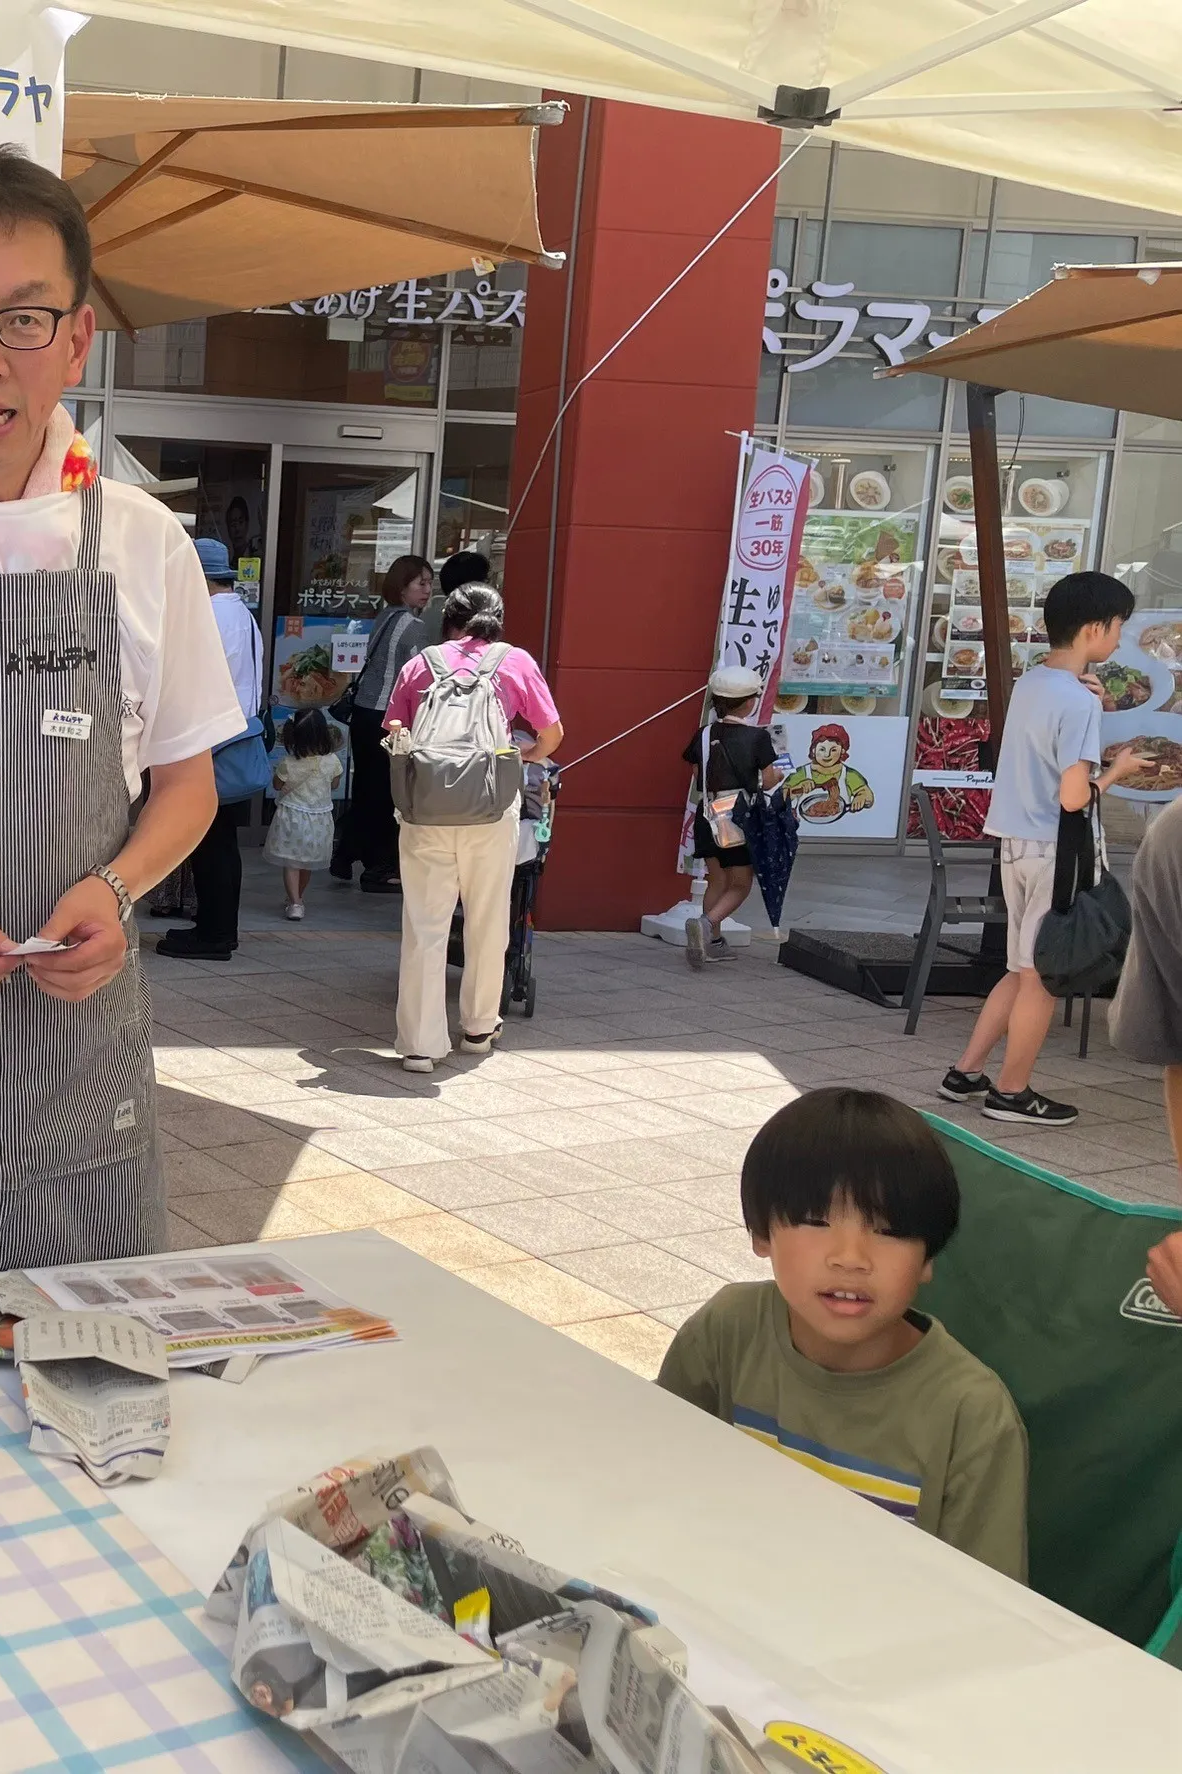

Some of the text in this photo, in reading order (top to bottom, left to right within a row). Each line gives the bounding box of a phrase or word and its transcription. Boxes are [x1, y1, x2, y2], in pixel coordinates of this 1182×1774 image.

[750, 488, 793, 508] 生パスタ
[755, 514, 783, 532] 一筋
[750, 539, 784, 557] 30年
[297, 588, 382, 610] ポポラマーマ
